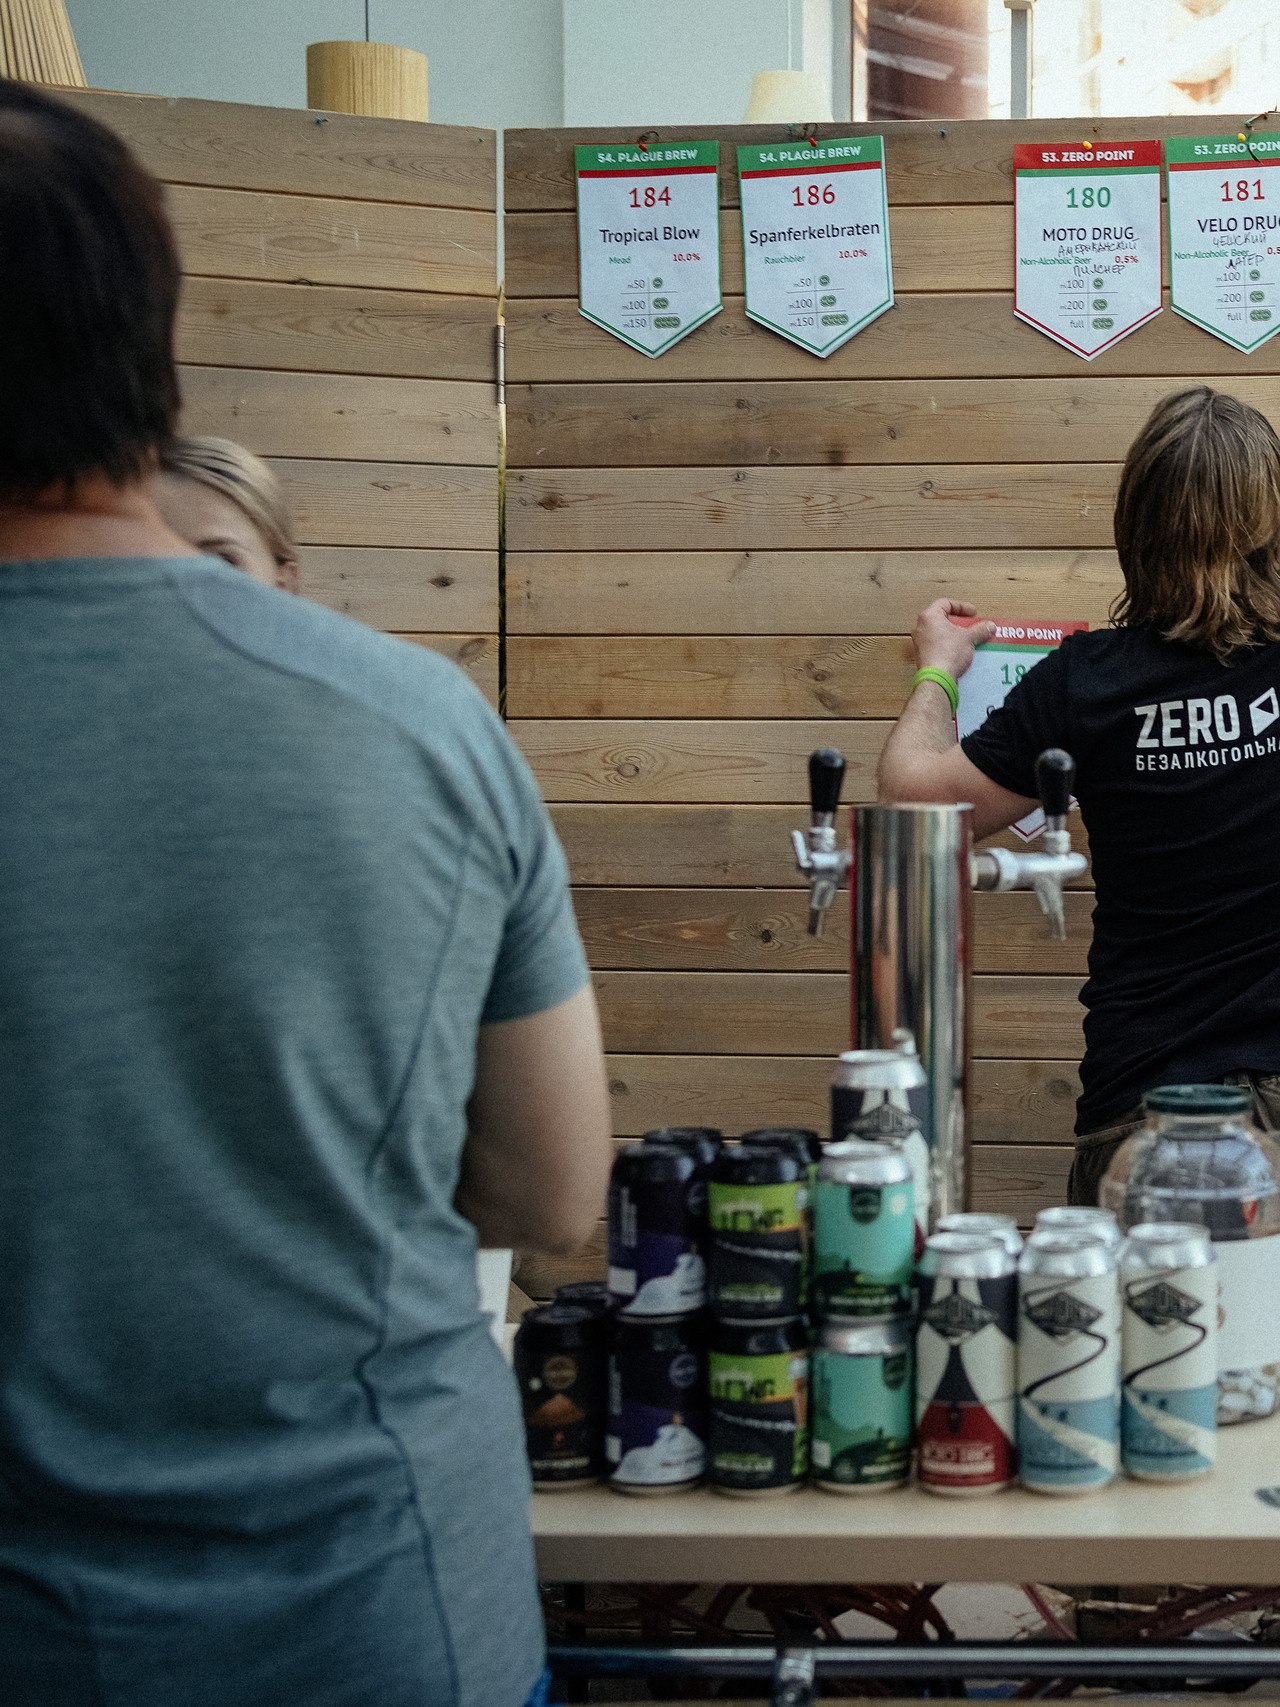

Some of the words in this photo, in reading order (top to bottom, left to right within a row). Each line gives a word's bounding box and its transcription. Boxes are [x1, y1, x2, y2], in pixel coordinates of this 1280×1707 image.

[598, 152, 615, 162] 54.
[618, 150, 663, 162] PLAGUE
[665, 149, 698, 160] BREW
[759, 152, 777, 163] 54.
[779, 149, 826, 162] PLAGUE
[828, 146, 862, 158] BREW
[1041, 151, 1060, 162] 53.
[1062, 151, 1095, 162] ZERO
[1096, 150, 1135, 161] POINT
[1194, 144, 1212, 156] 53.
[1214, 142, 1248, 154] ZERO
[628, 186, 672, 208] 184
[791, 184, 836, 207] 186
[1066, 186, 1112, 209] 180
[1220, 179, 1265, 202] 181
[1197, 217, 1238, 233] VELO
[599, 227, 659, 245] Tropical
[663, 226, 701, 240] Blow
[749, 223, 880, 246] Spanferkelbraten
[1042, 227, 1087, 242] MOTO
[1091, 226, 1135, 241] DRUG
[609, 255, 632, 265] Mead
[839, 249, 868, 259] 10.0%
[1020, 256, 1073, 265] Non-Alcoholic
[1074, 256, 1092, 265] Beer
[1114, 255, 1139, 264] 0.5%
[1174, 249, 1228, 260] Non-Alcoholic
[995, 626, 1026, 639] ZERO
[1027, 627, 1063, 641] POINT
[1001, 663, 1033, 685] 18
[1134, 694, 1240, 748] ZERO
